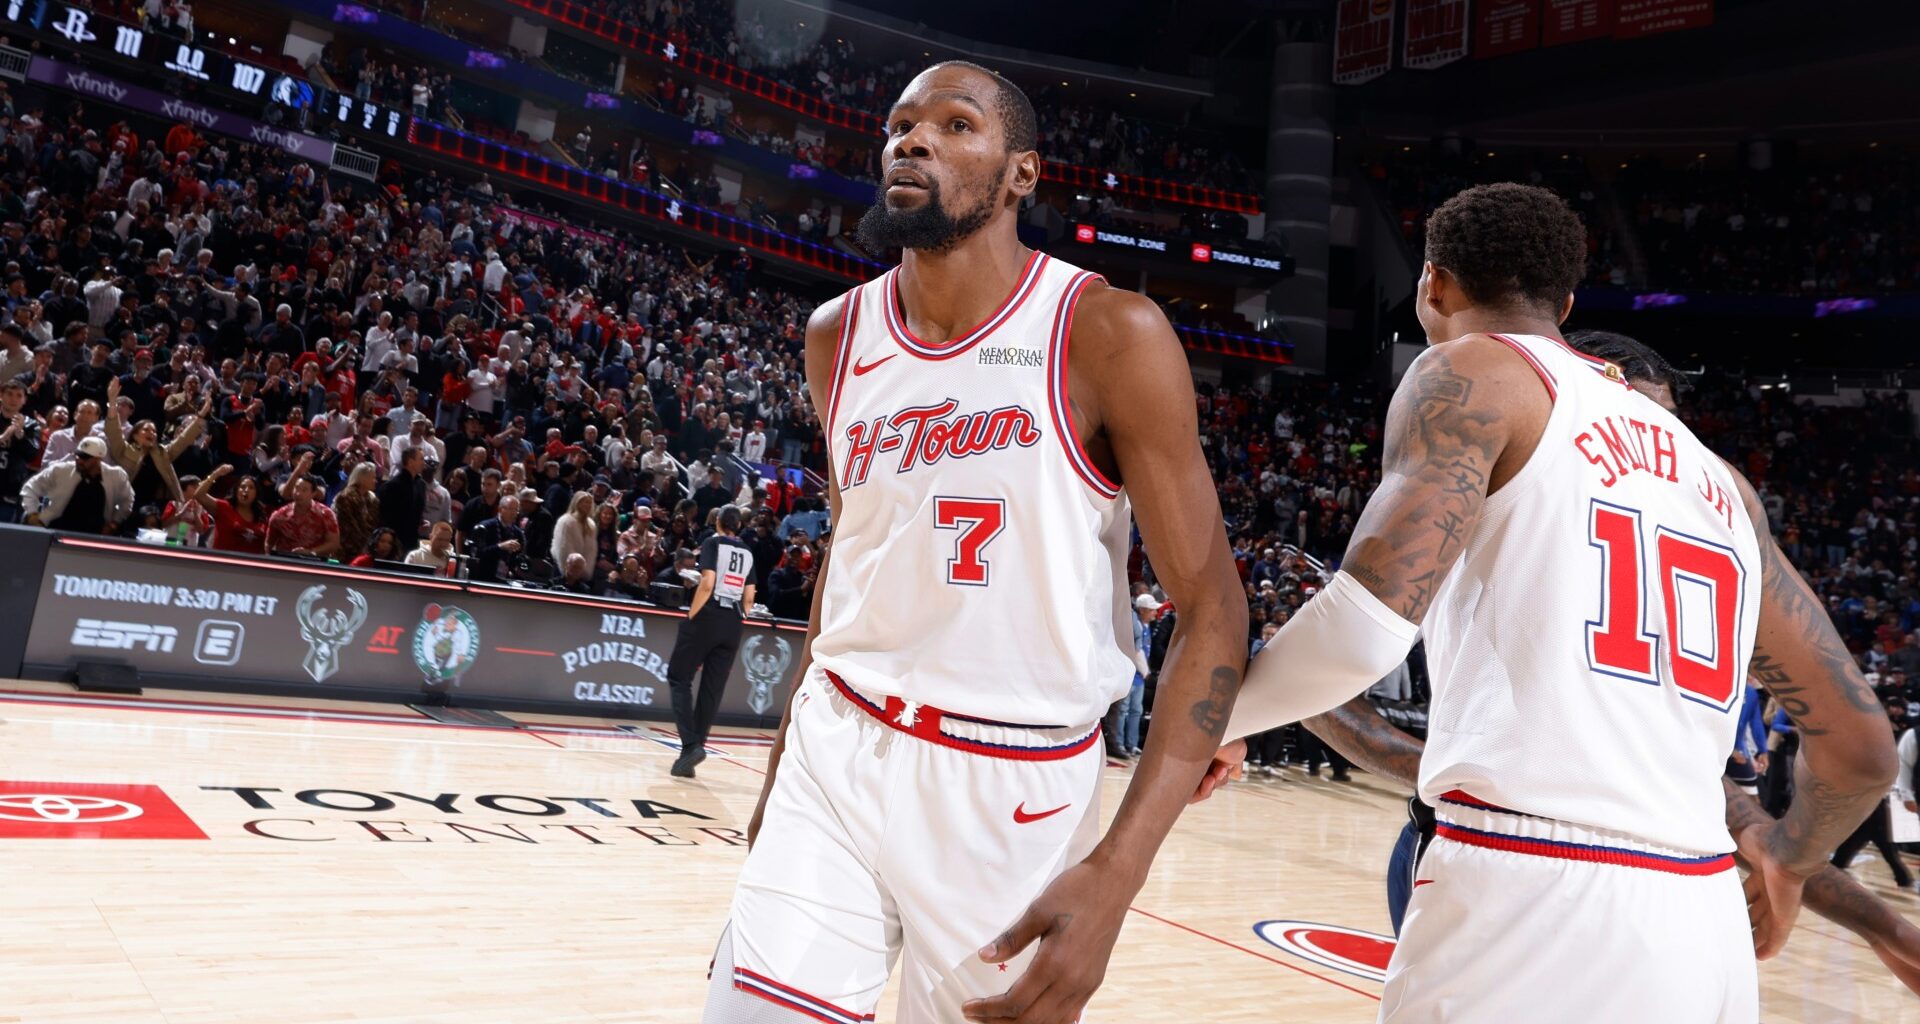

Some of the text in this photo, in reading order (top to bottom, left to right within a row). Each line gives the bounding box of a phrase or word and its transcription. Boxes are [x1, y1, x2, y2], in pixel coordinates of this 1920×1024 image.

[66, 71, 128, 102] xfinity
[232, 62, 266, 94] 107
[160, 99, 219, 127] xfinity
[250, 124, 304, 151] xfinity
[1096, 231, 1167, 251] TUNDRA ZONE
[1212, 251, 1281, 270] TUNDRA ZONE
[978, 354, 1043, 367] HERMANN
[979, 347, 1043, 360] MEMORIAL
[841, 398, 1042, 492] H-Town
[1574, 415, 1679, 488] SMITH
[933, 496, 1006, 586] 7
[729, 551, 744, 574] 81
[53, 574, 279, 616] TOMORROW 3:30 PM ET
[1585, 497, 1746, 714] 10
[70, 618, 178, 653] ESPN
[369, 625, 404, 649] AT
[600, 614, 646, 638] NBA
[561, 641, 670, 683] PIONEERS
[574, 681, 655, 705] CLASSIC
[198, 785, 717, 820] TOYOTA
[243, 818, 750, 847] CENTER
